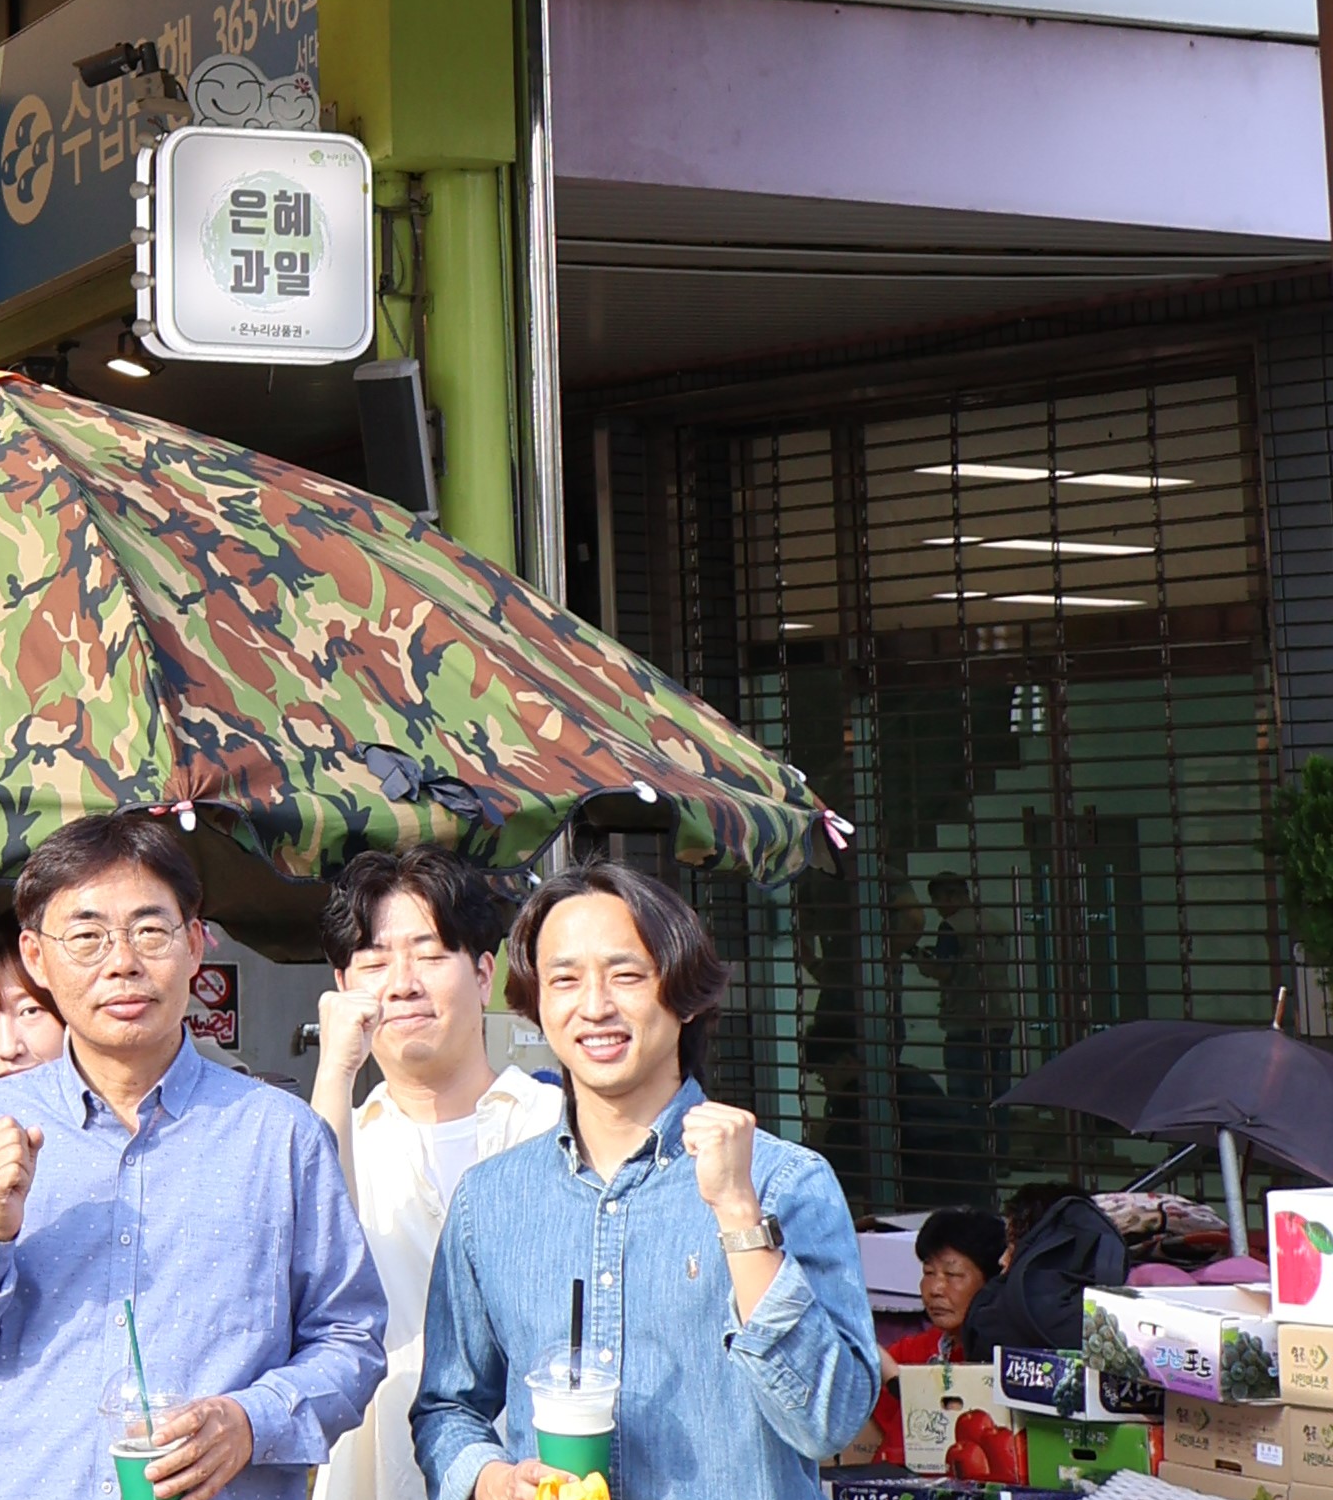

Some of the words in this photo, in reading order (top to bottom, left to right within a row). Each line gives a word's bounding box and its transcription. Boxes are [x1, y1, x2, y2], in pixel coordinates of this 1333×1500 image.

[61, 14, 193, 186] 수협행
[229, 189, 312, 237] 은혜
[230, 249, 311, 297] 과일
[239, 322, 303, 338] 온누리상품권
[1005, 1359, 1045, 1388] 상주포도
[1152, 1346, 1213, 1380] 고산포도
[1302, 1451, 1333, 1467] 샤인머스
